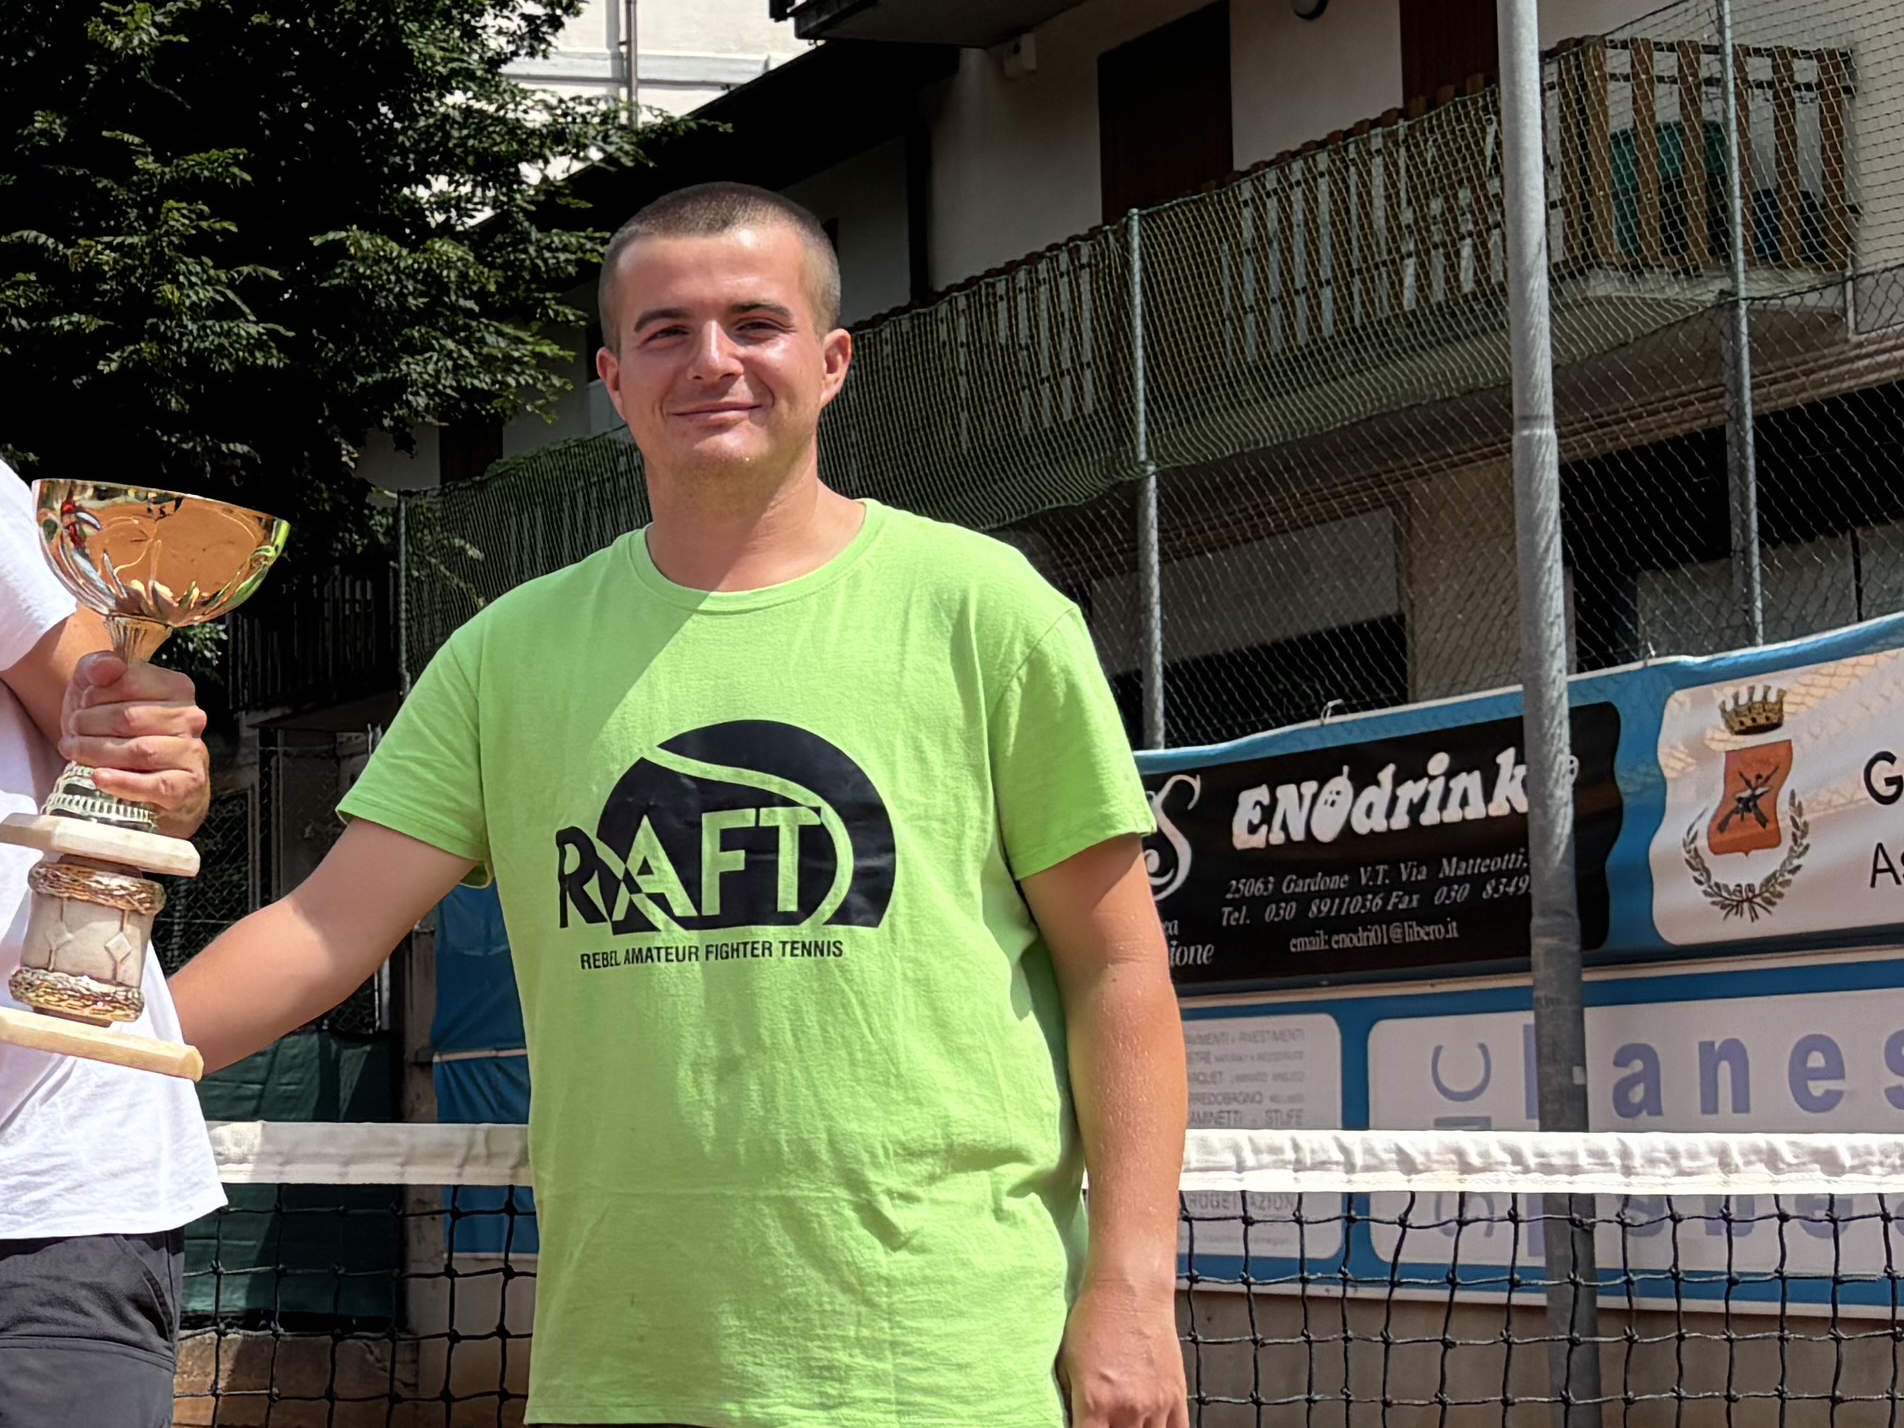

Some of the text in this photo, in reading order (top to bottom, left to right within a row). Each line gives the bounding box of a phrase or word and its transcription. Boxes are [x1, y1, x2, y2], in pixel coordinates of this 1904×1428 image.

[555, 806, 822, 928] RAFT
[1225, 876, 1274, 900] 25063
[1282, 872, 1349, 895] Gardone
[1360, 865, 1390, 886] V.T.
[1400, 861, 1428, 882] Via
[1221, 875, 1531, 926] Tel. 030 8911036 Fax 030 8349
[580, 939, 844, 970] REBEL AMATEUR FIGHTER TENNIS
[1169, 940, 1215, 967] ione
[1289, 930, 1329, 953] email:
